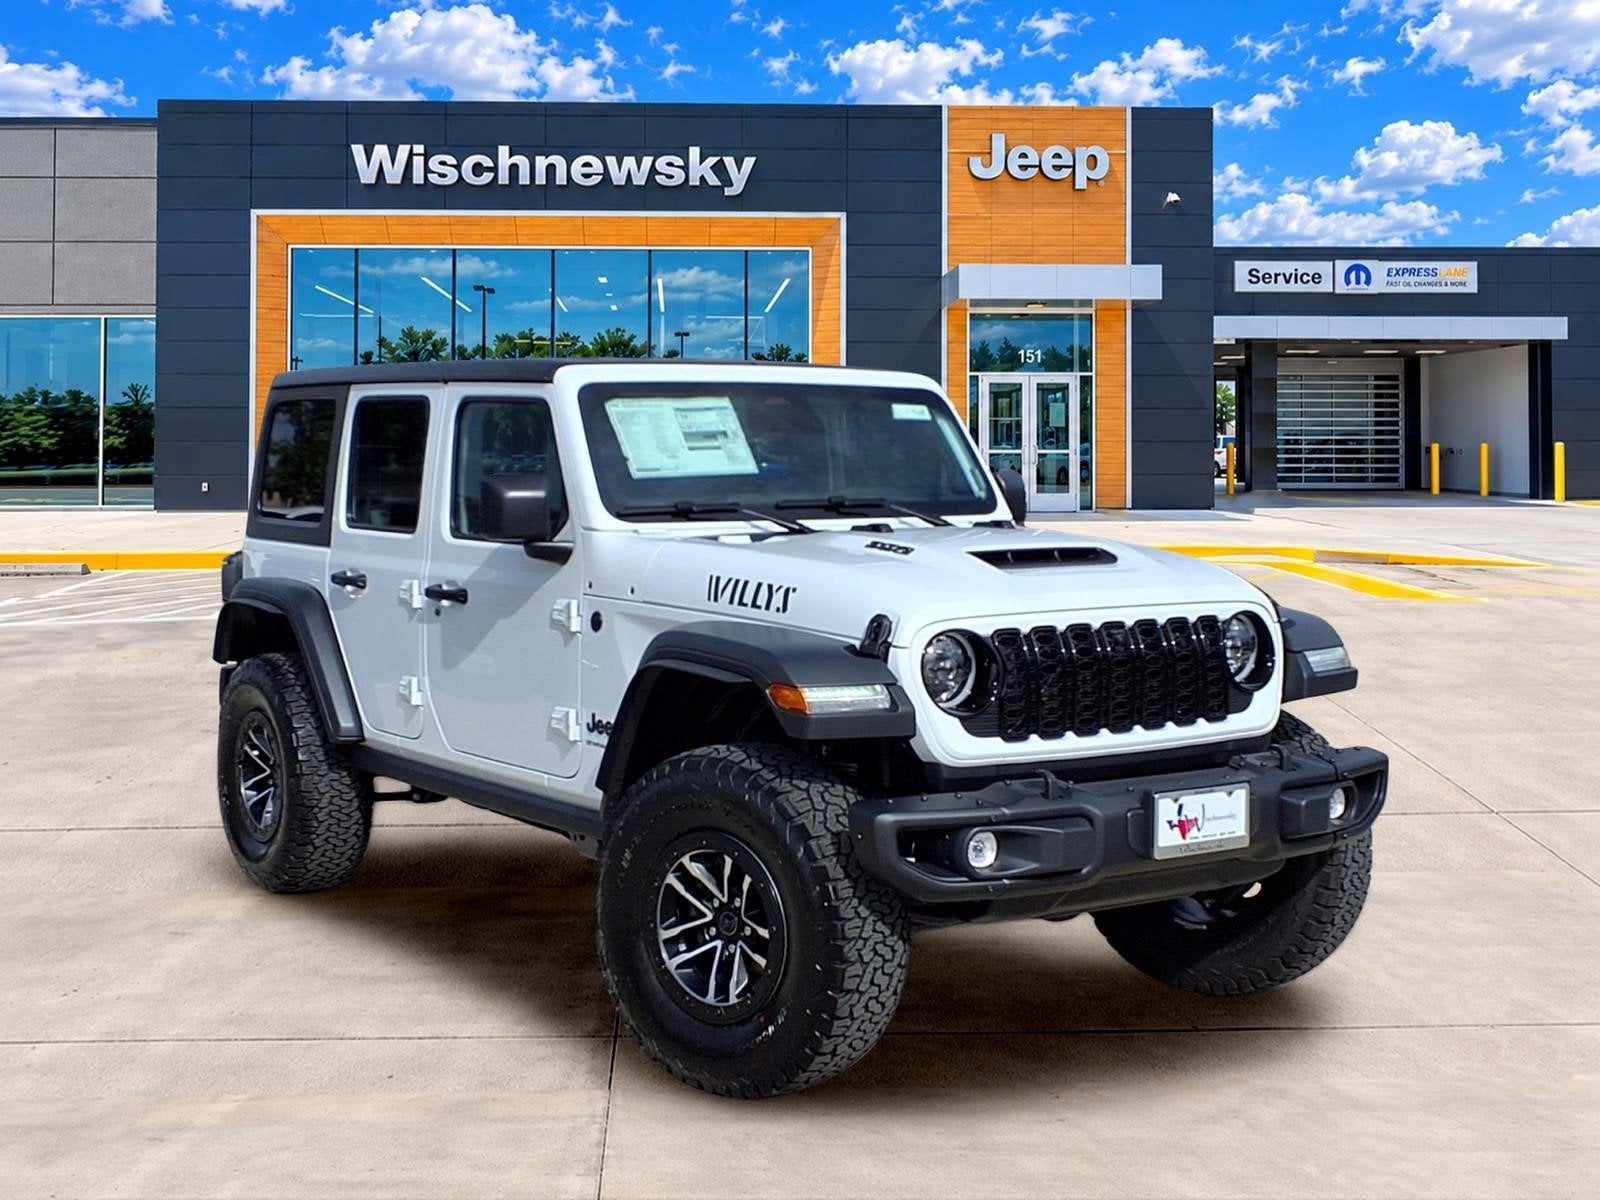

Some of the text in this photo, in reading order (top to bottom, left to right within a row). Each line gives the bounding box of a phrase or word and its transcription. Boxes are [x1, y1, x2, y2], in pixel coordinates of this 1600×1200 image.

[350, 143, 757, 197] Wischnewsky
[968, 132, 1110, 190] Jeep
[1247, 268, 1323, 286] Service
[1018, 349, 1042, 364] 151
[707, 574, 798, 614] WILLYS
[586, 712, 613, 736] Jee
